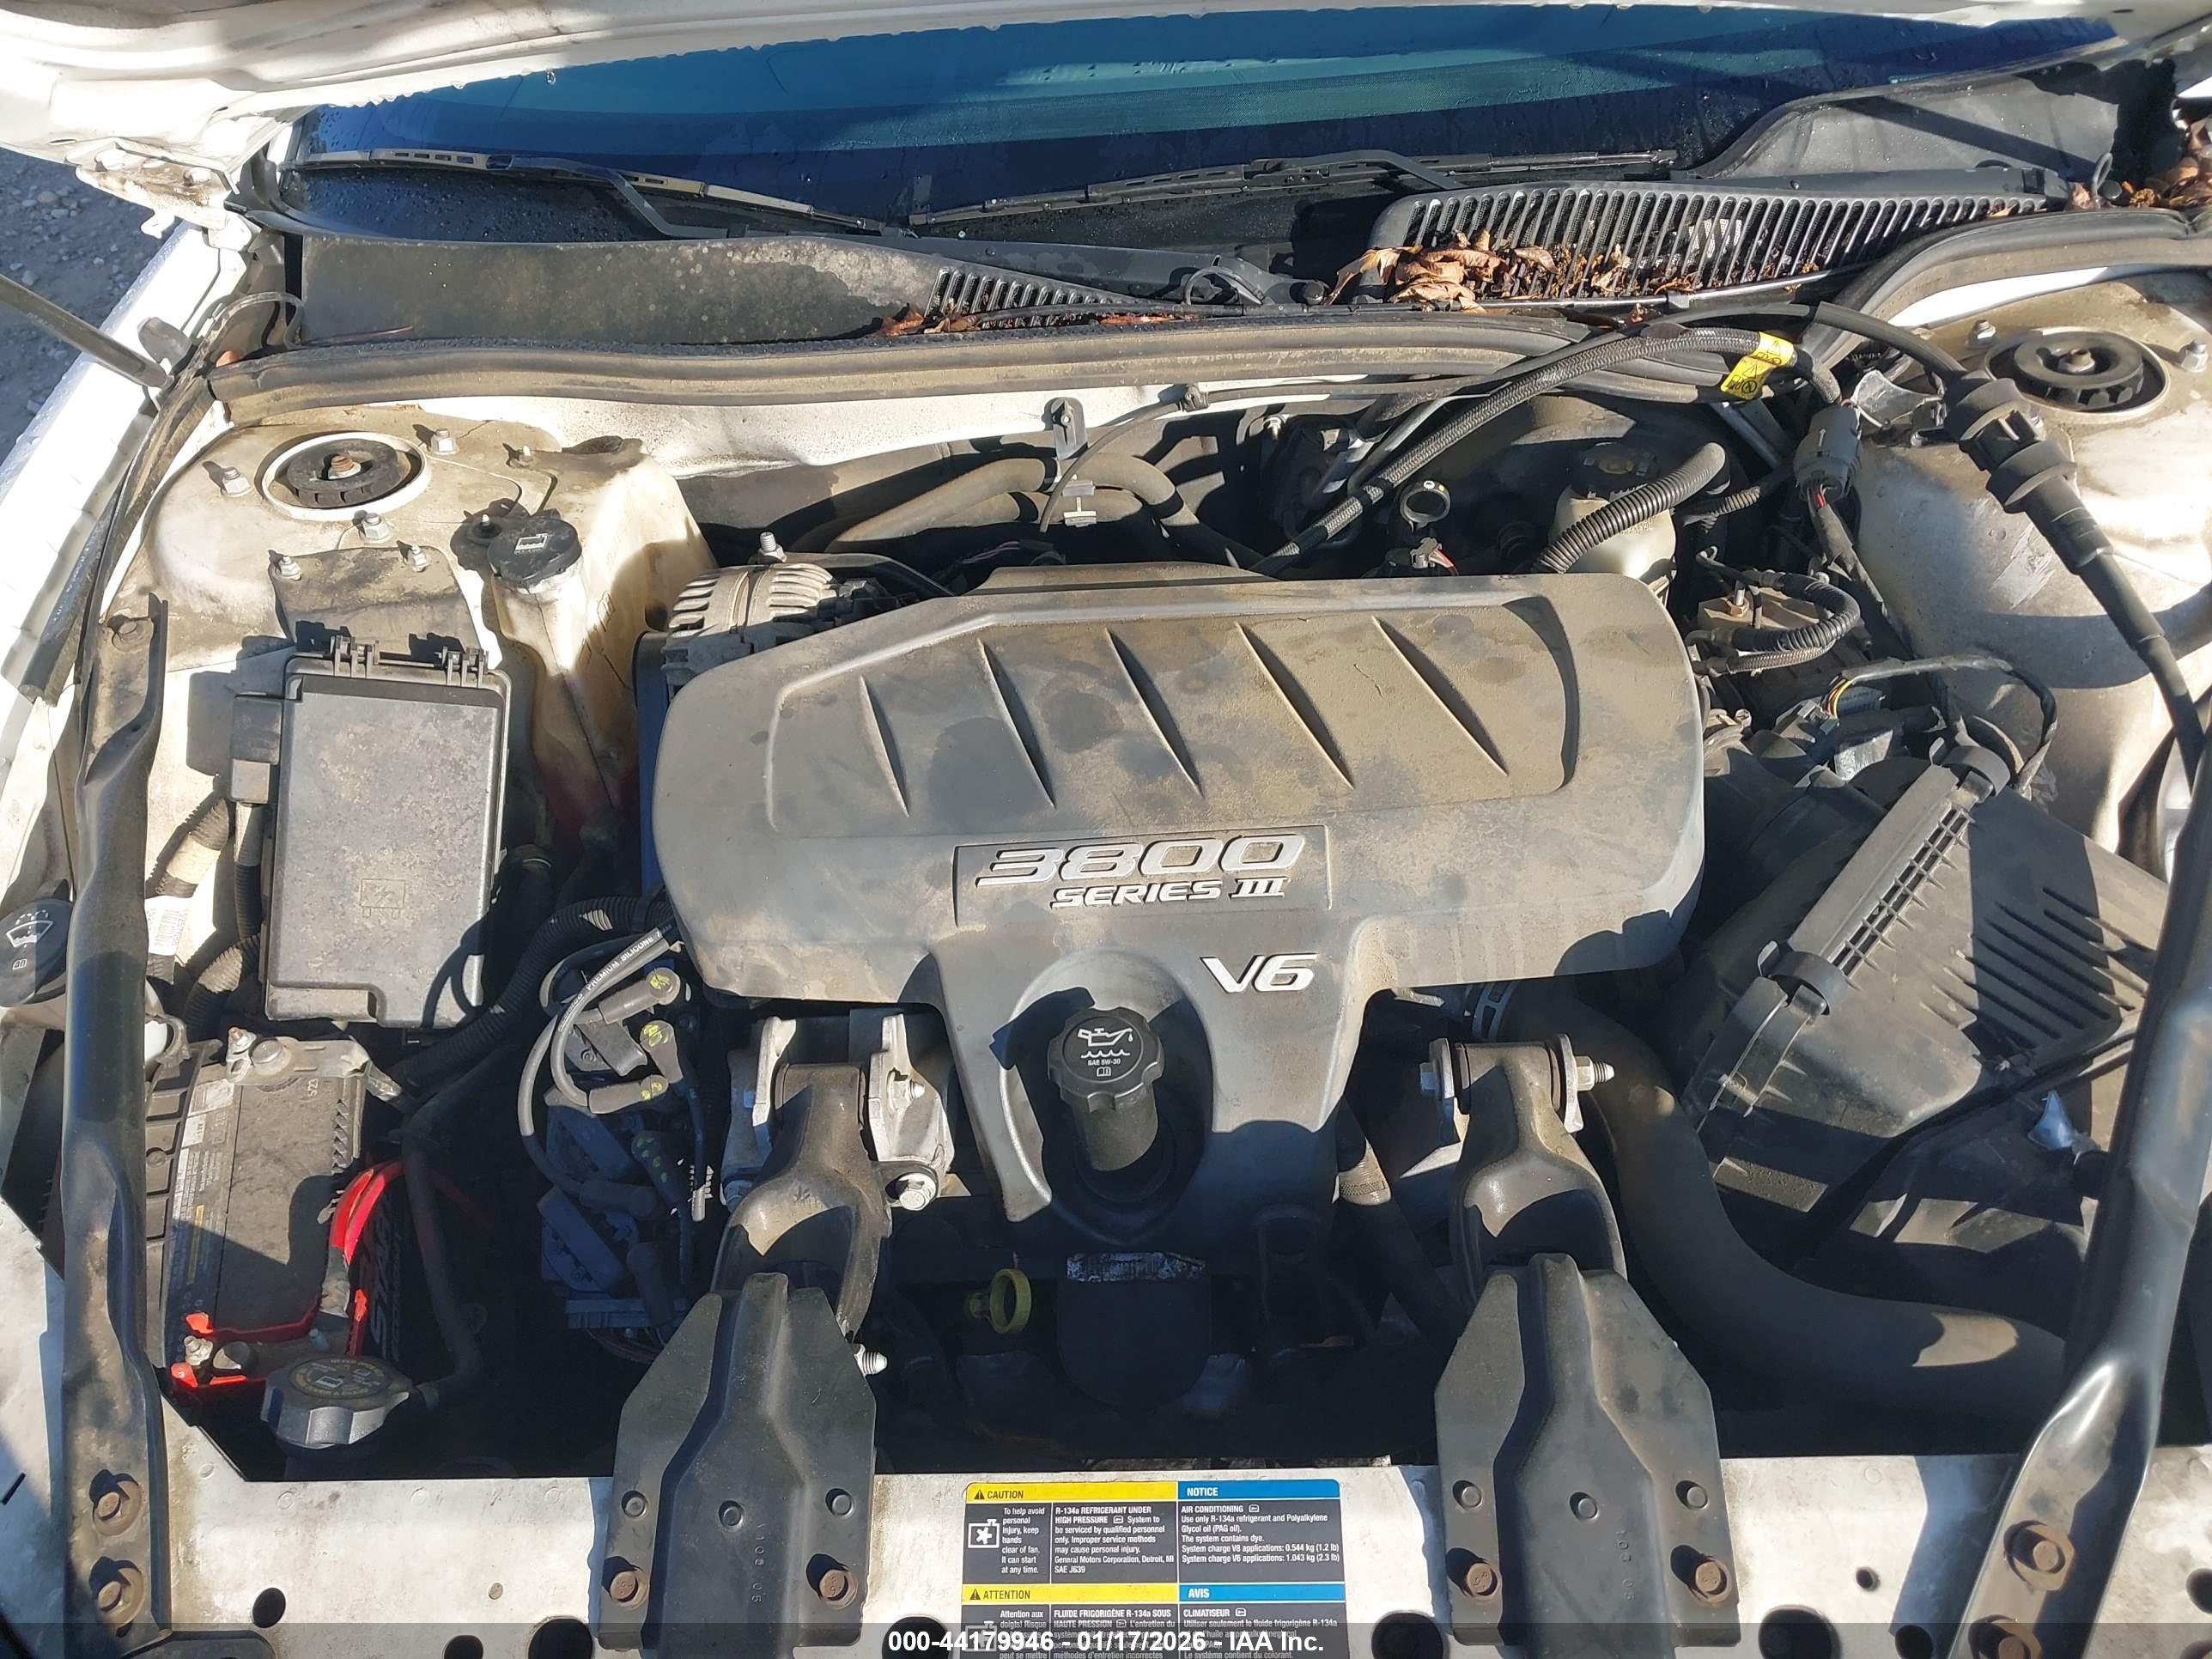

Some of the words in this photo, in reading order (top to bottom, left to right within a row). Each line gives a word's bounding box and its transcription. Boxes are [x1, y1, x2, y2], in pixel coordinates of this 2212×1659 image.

[975, 835, 1305, 888] 3800
[1049, 879, 1224, 909] SERIES
[1228, 876, 1289, 900] III
[586, 961, 619, 991] PREMIUM
[620, 937, 654, 962] SILICONE
[1200, 952, 1320, 994] V6
[988, 1490, 1024, 1499] CAUTION
[1187, 1487, 1218, 1497] NOTICE
[1012, 1507, 1026, 1516] help
[1194, 1504, 1243, 1513] CONDITIONING
[1003, 1516, 1030, 1525] personal
[1127, 1516, 1153, 1524] System
[1195, 1515, 1209, 1523] only
[1237, 1515, 1271, 1523] refrigerant
[1286, 1514, 1328, 1522] Polyalkylene
[1003, 1526, 1021, 1534] injury,
[1094, 1526, 1102, 1534] by
[1103, 1525, 1131, 1534] qualified
[1133, 1525, 1164, 1534] personnel
[1182, 1525, 1201, 1534] Glycol
[1212, 1525, 1229, 1534] (PAG
[1230, 1525, 1242, 1534] oil).
[1054, 1536, 1069, 1545] only.
[1072, 1535, 1101, 1545] Improper
[1250, 1534, 1264, 1543] dye.
[1054, 1547, 1068, 1555] may
[1091, 1546, 1119, 1555] personal
[1121, 1546, 1140, 1554] injury.
[1182, 1545, 1206, 1553] System
[1208, 1545, 1231, 1553] charge
[1242, 1544, 1284, 1553] applications:
[1306, 1544, 1315, 1553] kg
[1316, 1544, 1329, 1553] (1.2
[1103, 1555, 1140, 1565] Corporation,
[1142, 1555, 1164, 1564] Detroit,
[1182, 1555, 1206, 1564] System
[1208, 1555, 1231, 1564] charge
[1243, 1554, 1285, 1563] applications:
[1307, 1554, 1316, 1563] kg
[1316, 1554, 1329, 1563] (2.3
[983, 1590, 1030, 1600] ATTENTION
[1188, 1589, 1209, 1598] AVIS
[1127, 1609, 1151, 1618] R-134a
[1152, 1609, 1171, 1618] SOUS
[1000, 1620, 1022, 1630] doigts!
[1024, 1620, 1047, 1630] Risque
[1079, 1620, 1112, 1628] PRESSION
[1129, 1620, 1165, 1628] L'entretien
[1274, 1619, 1311, 1628] frigorigène
[1025, 1650, 1047, 1659] mettre
[1087, 1650, 1123, 1659] d'entretien
[1124, 1650, 1163, 1659] incorrectes
[1194, 1650, 1222, 1659] système
[1224, 1650, 1252, 1659] contient
[1264, 1650, 1293, 1659] colorant.
